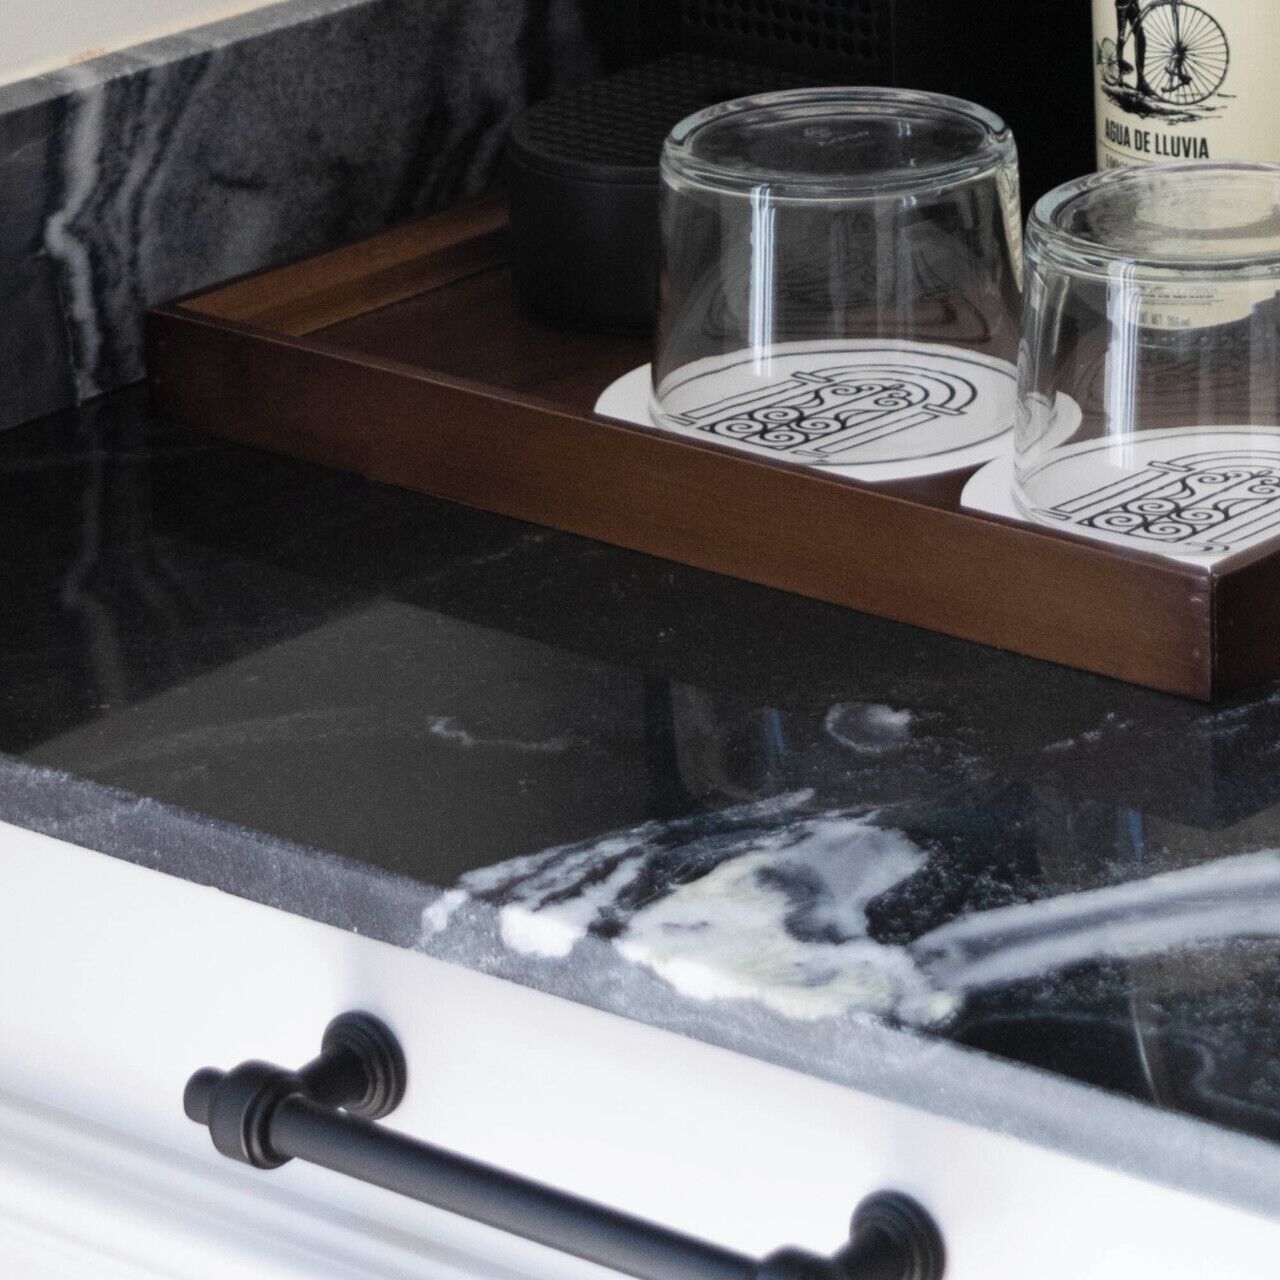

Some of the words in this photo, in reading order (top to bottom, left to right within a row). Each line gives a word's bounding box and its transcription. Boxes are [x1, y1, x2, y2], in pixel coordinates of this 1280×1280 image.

[1105, 118, 1130, 148] AGUA
[1135, 129, 1151, 153] DE
[1155, 132, 1209, 159] LLUVIA
